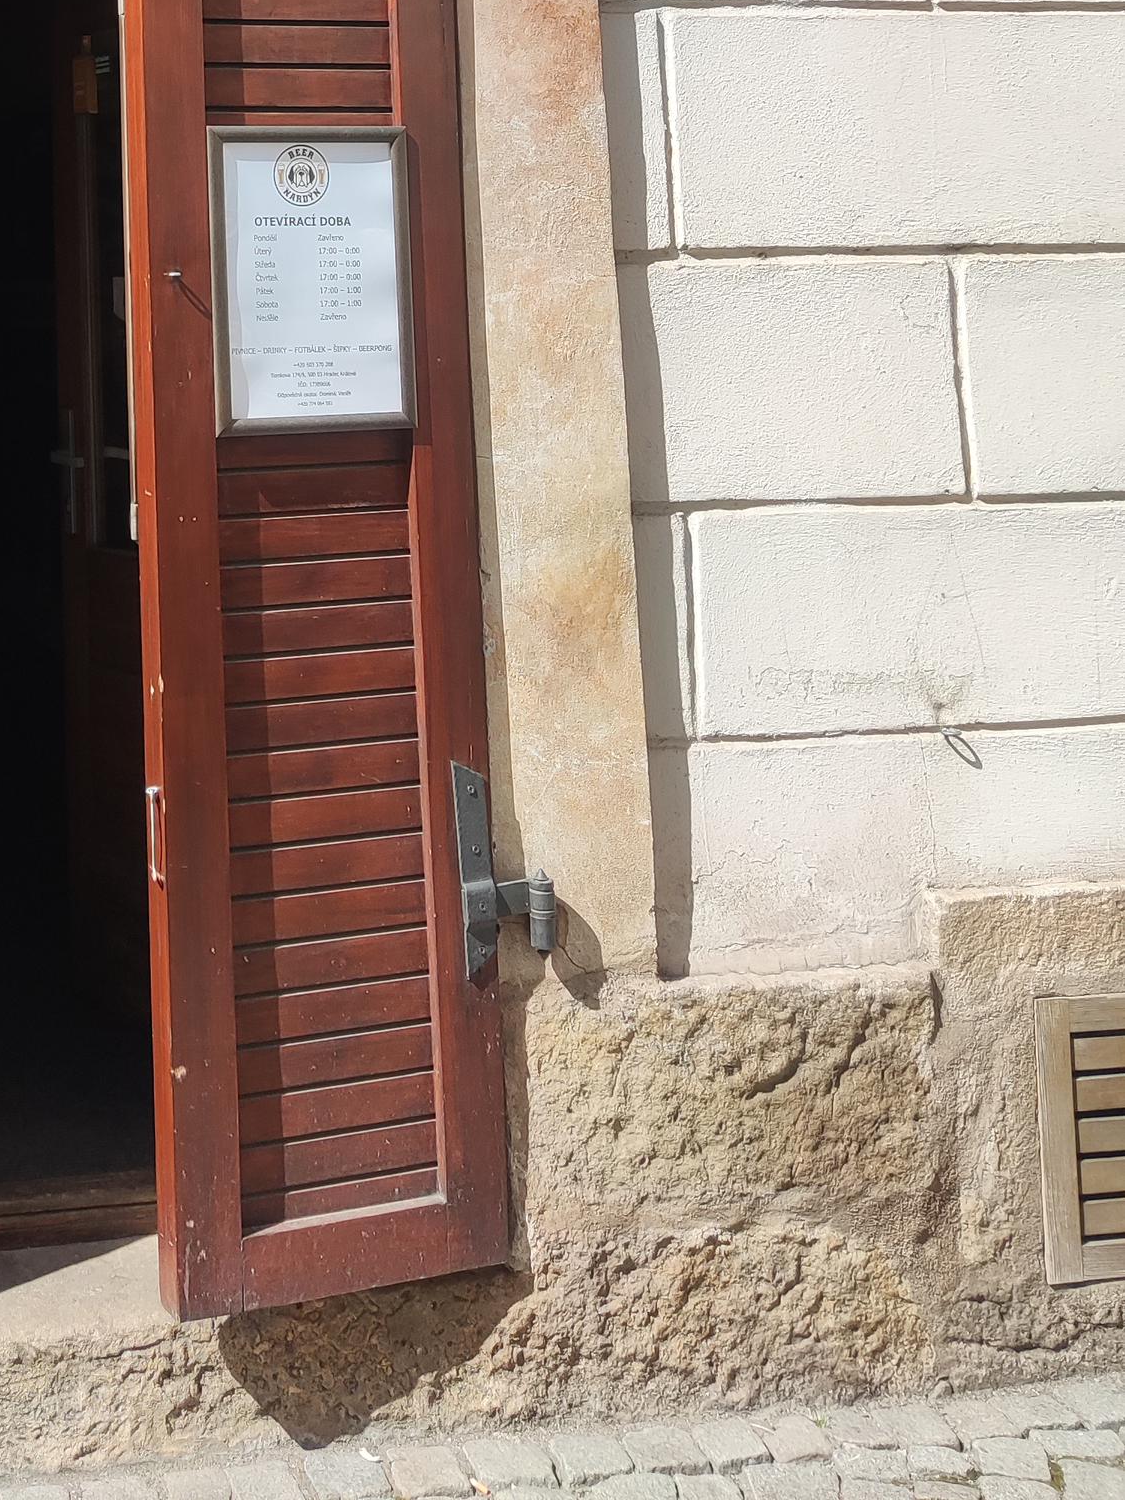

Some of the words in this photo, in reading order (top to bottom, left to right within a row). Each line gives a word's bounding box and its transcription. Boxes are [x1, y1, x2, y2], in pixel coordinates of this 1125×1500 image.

[287, 148, 314, 160] BEER
[254, 213, 317, 227] OTEVÍRACÍ
[319, 216, 352, 227] DOBA
[318, 247, 338, 255] 17:00
[319, 260, 338, 268] 17:00
[319, 273, 338, 281] 17:00
[320, 286, 339, 294] 17:00
[346, 286, 362, 294] 1:00
[255, 300, 279, 308] Sobota
[320, 300, 339, 308] 17:00
[347, 299, 362, 307] 1:00
